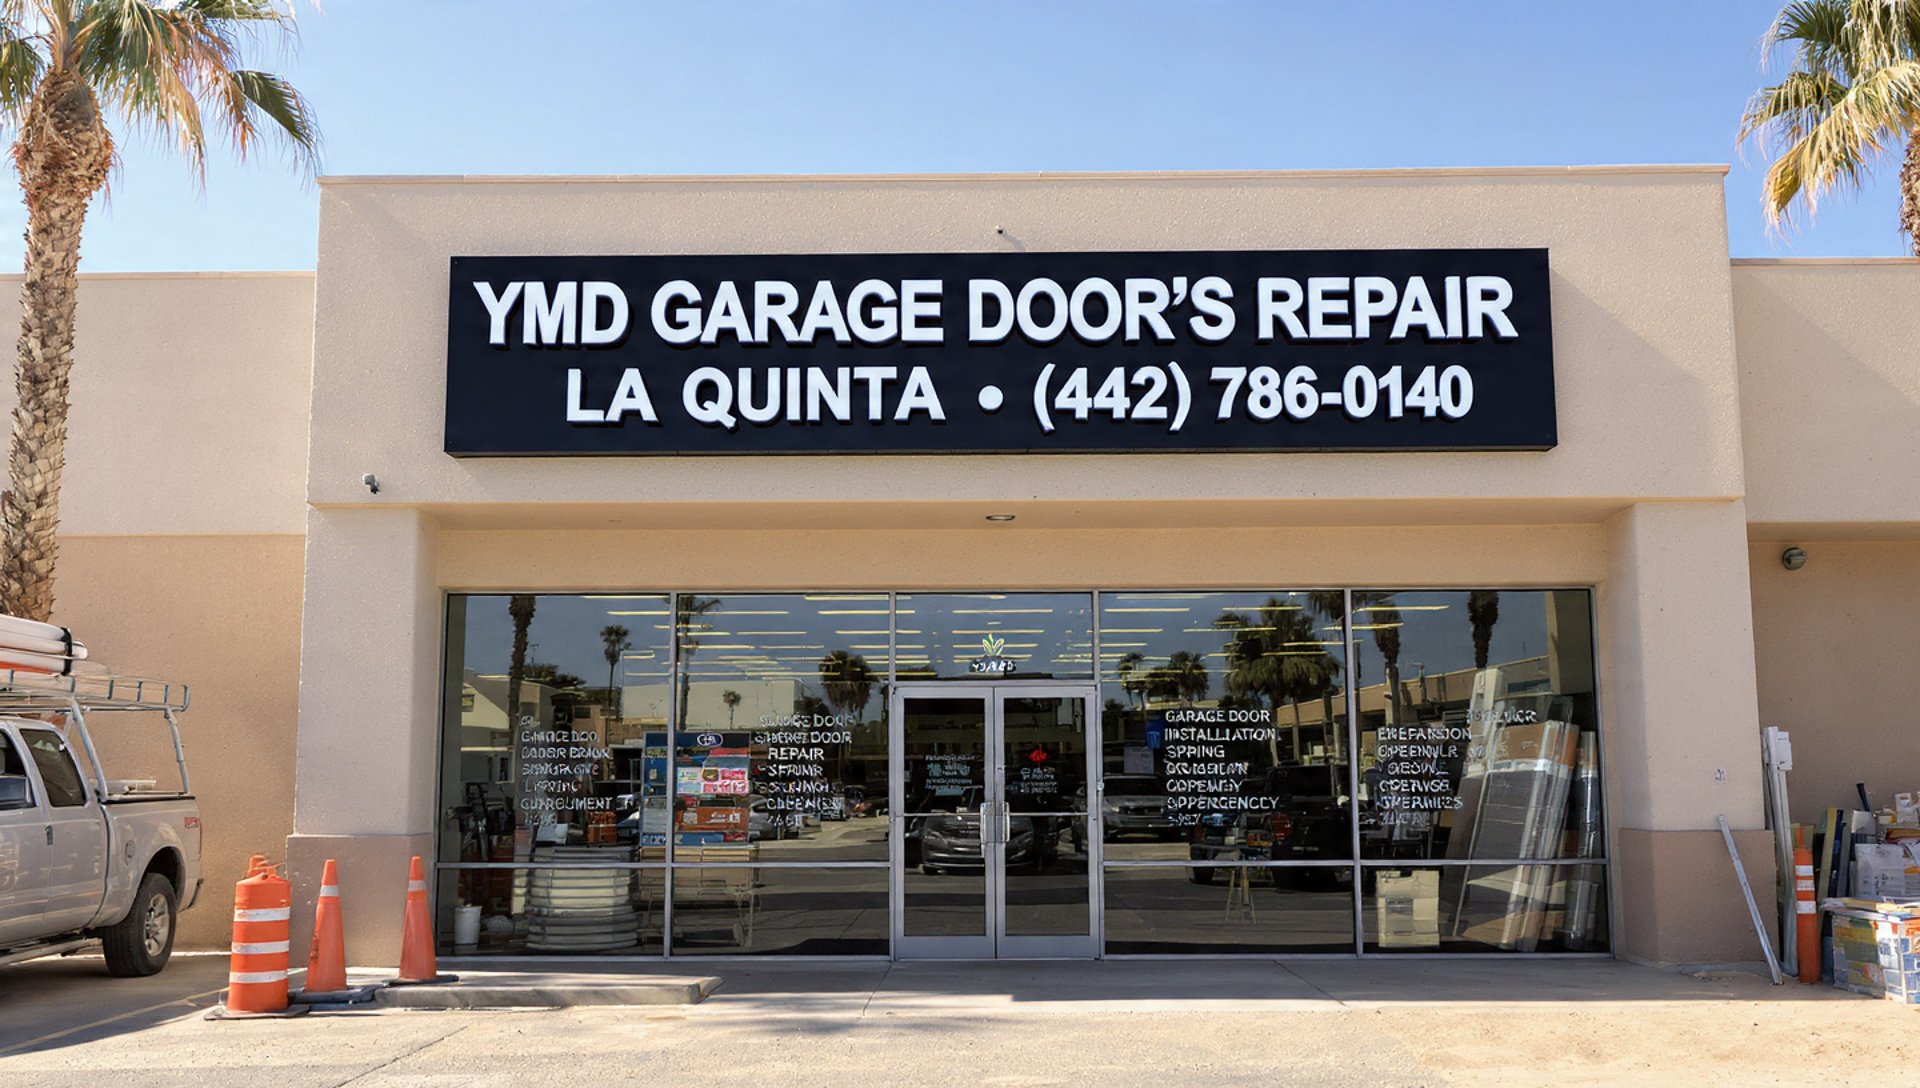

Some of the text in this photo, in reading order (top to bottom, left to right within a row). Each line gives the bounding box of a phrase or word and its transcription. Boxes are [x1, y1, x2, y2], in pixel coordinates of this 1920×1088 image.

[473, 275, 1519, 345] YMD GARAGE DOOR'S REPAIR
[566, 360, 1474, 432] LA QUINTA (442) 786-0140
[1165, 709, 1271, 723] GARAGE DOOR
[767, 747, 825, 761] REPAIR
[1165, 744, 1226, 759] SPRING
